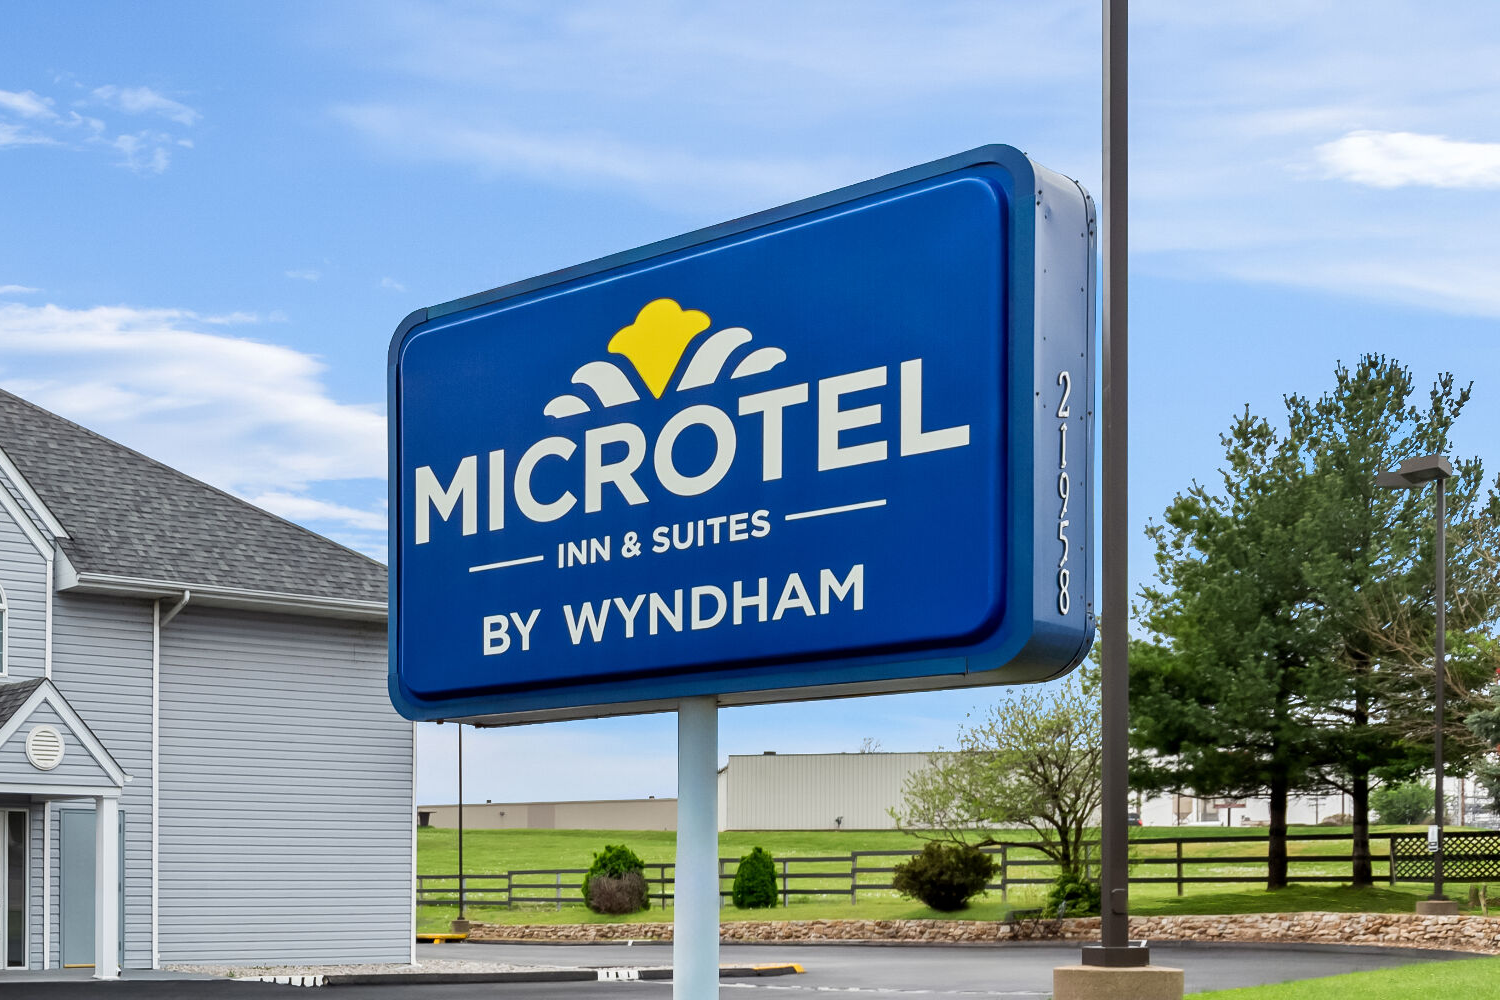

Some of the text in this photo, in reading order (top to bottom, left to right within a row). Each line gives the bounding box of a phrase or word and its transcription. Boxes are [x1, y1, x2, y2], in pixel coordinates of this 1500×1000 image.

[415, 358, 970, 545] MICROTEL
[1056, 370, 1072, 616] 21958
[558, 509, 771, 568] INN & SUITES
[483, 564, 864, 656] BY WYNDHAM
